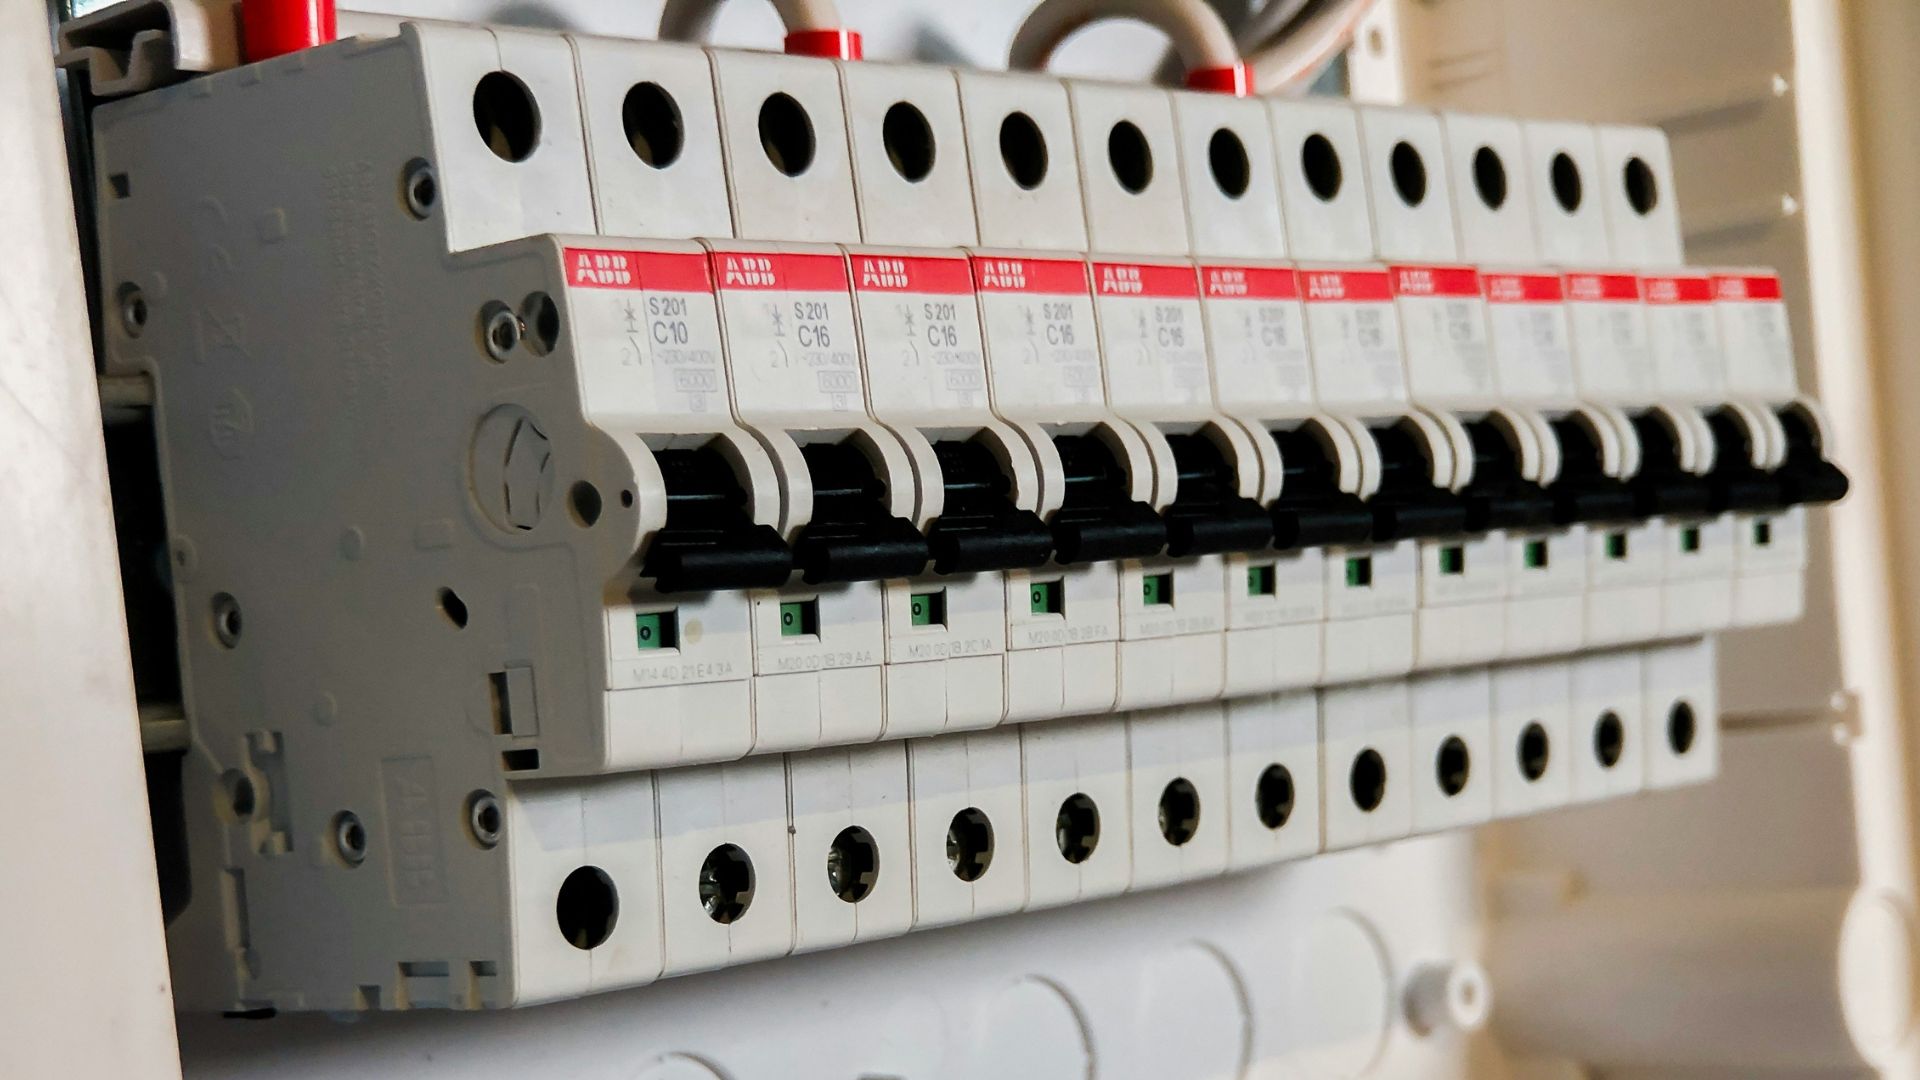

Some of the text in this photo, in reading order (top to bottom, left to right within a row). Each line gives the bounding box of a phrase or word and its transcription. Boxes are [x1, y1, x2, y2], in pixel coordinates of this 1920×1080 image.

[576, 253, 631, 285] ABB
[726, 257, 776, 286] ABB
[863, 259, 908, 288] ABB
[983, 261, 1026, 289] ABB
[1102, 266, 1143, 294] ABB
[1210, 269, 1248, 296] ABB
[653, 320, 689, 345] C10
[798, 324, 831, 348] C16
[927, 324, 958, 348] C16
[1046, 324, 1075, 345] C16
